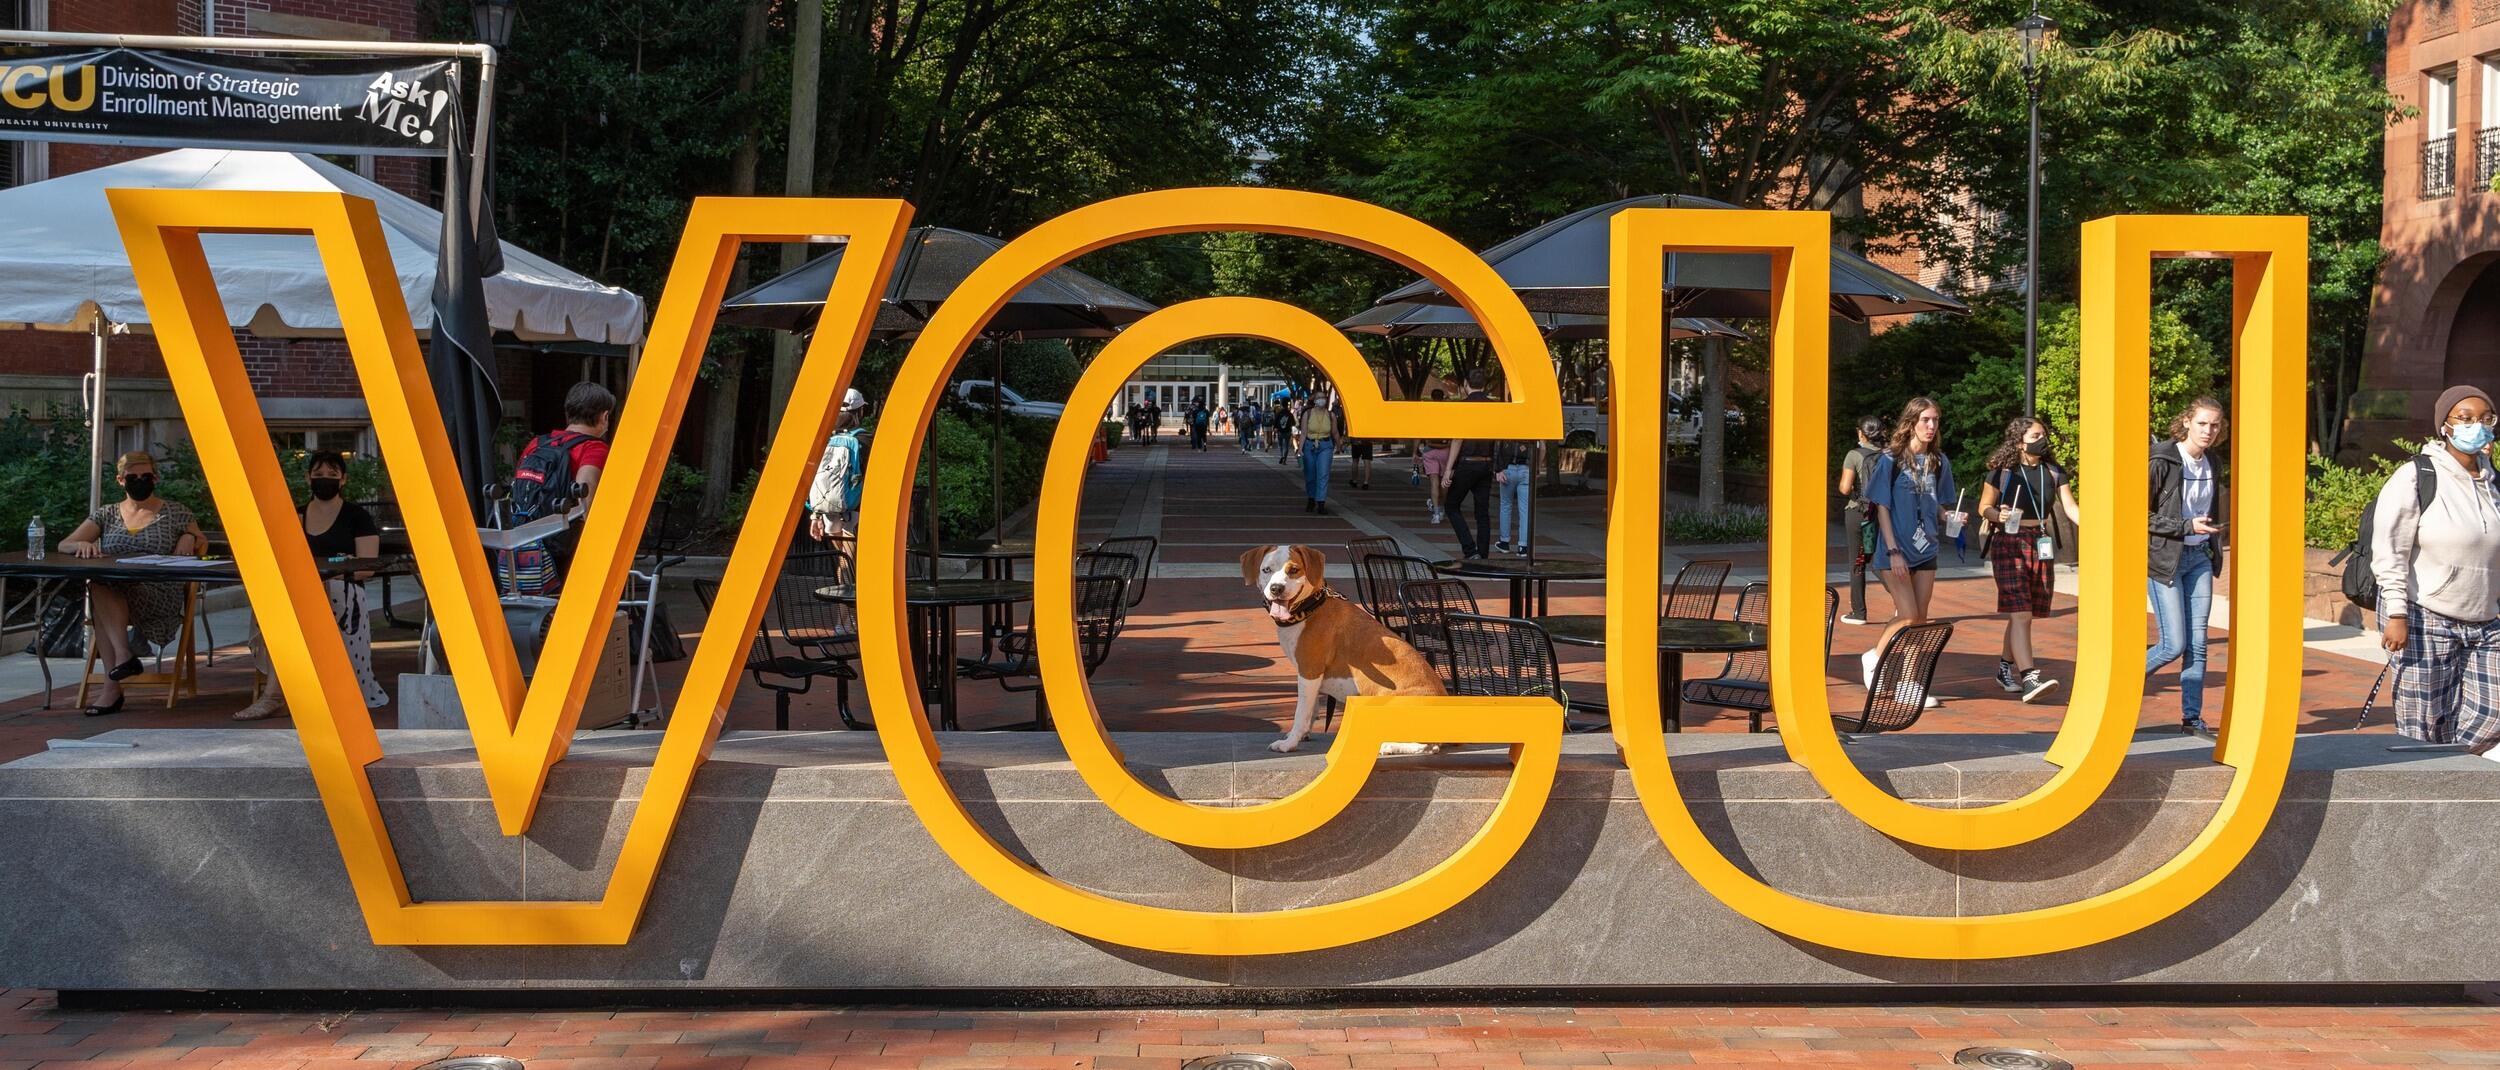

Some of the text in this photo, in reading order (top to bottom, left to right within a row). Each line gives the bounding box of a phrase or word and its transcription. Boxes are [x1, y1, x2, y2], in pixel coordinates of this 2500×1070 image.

[102, 66, 300, 99] Division of Strategic
[369, 71, 431, 108] Ask
[44, 120, 109, 130] UNIVERSITY
[102, 91, 342, 124] Enrollment Management
[354, 89, 449, 144] Me!
[106, 187, 2308, 960] VCU
